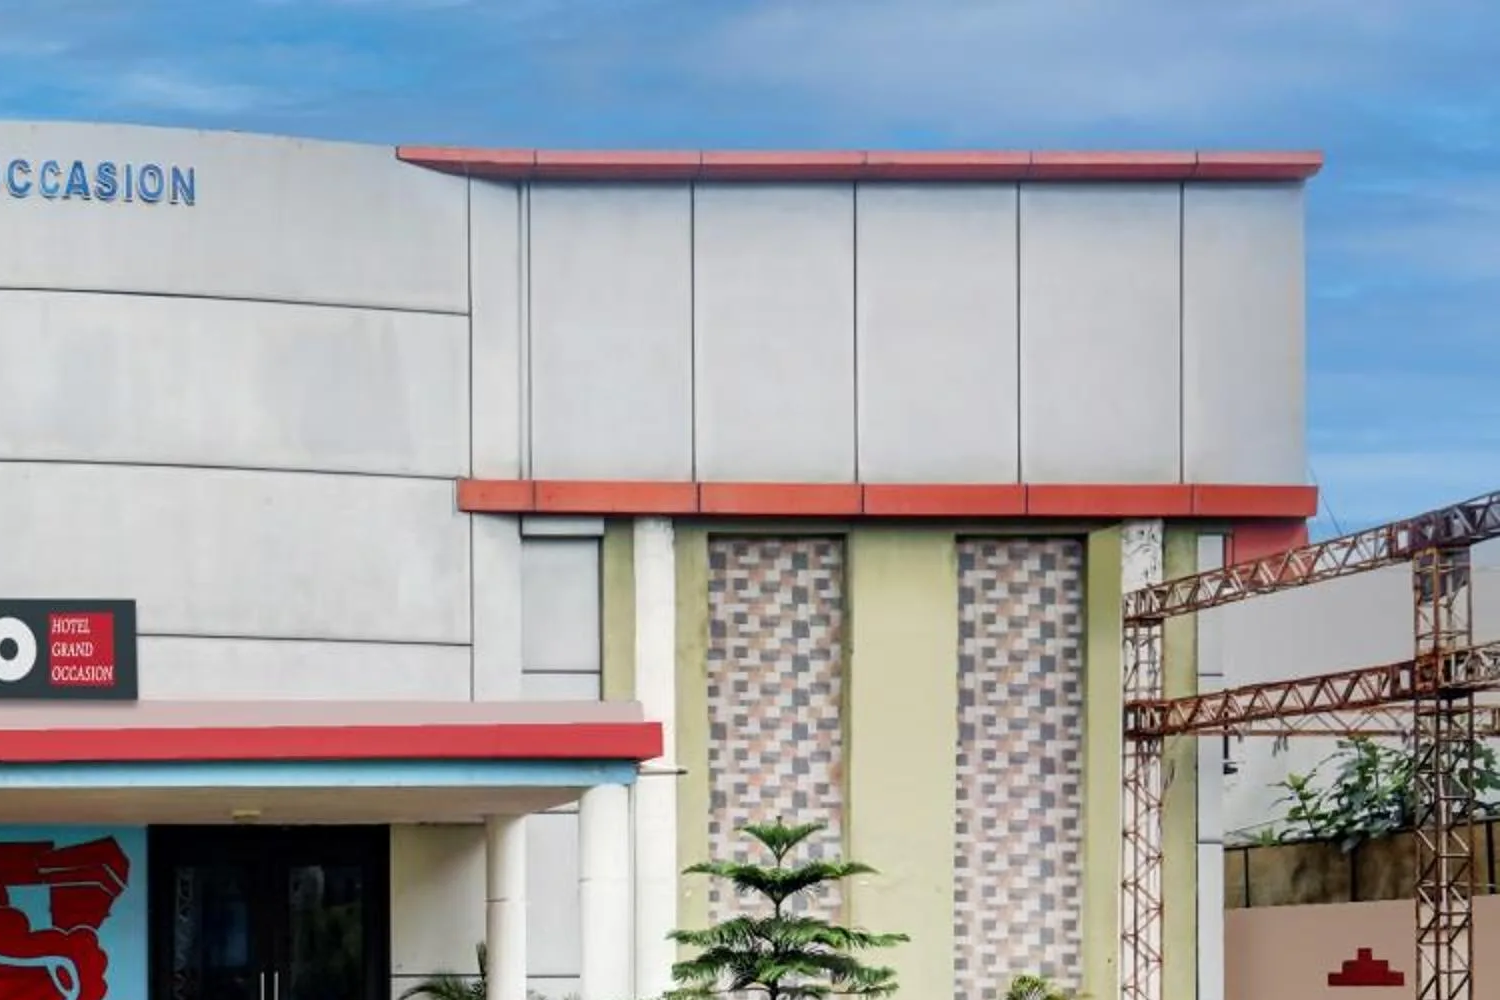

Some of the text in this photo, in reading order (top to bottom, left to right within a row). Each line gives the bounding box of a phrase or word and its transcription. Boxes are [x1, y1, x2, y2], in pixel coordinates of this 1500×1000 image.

[51, 617, 91, 634] HOTEL
[51, 641, 94, 657] GRAND
[51, 664, 114, 682] OCCASION
